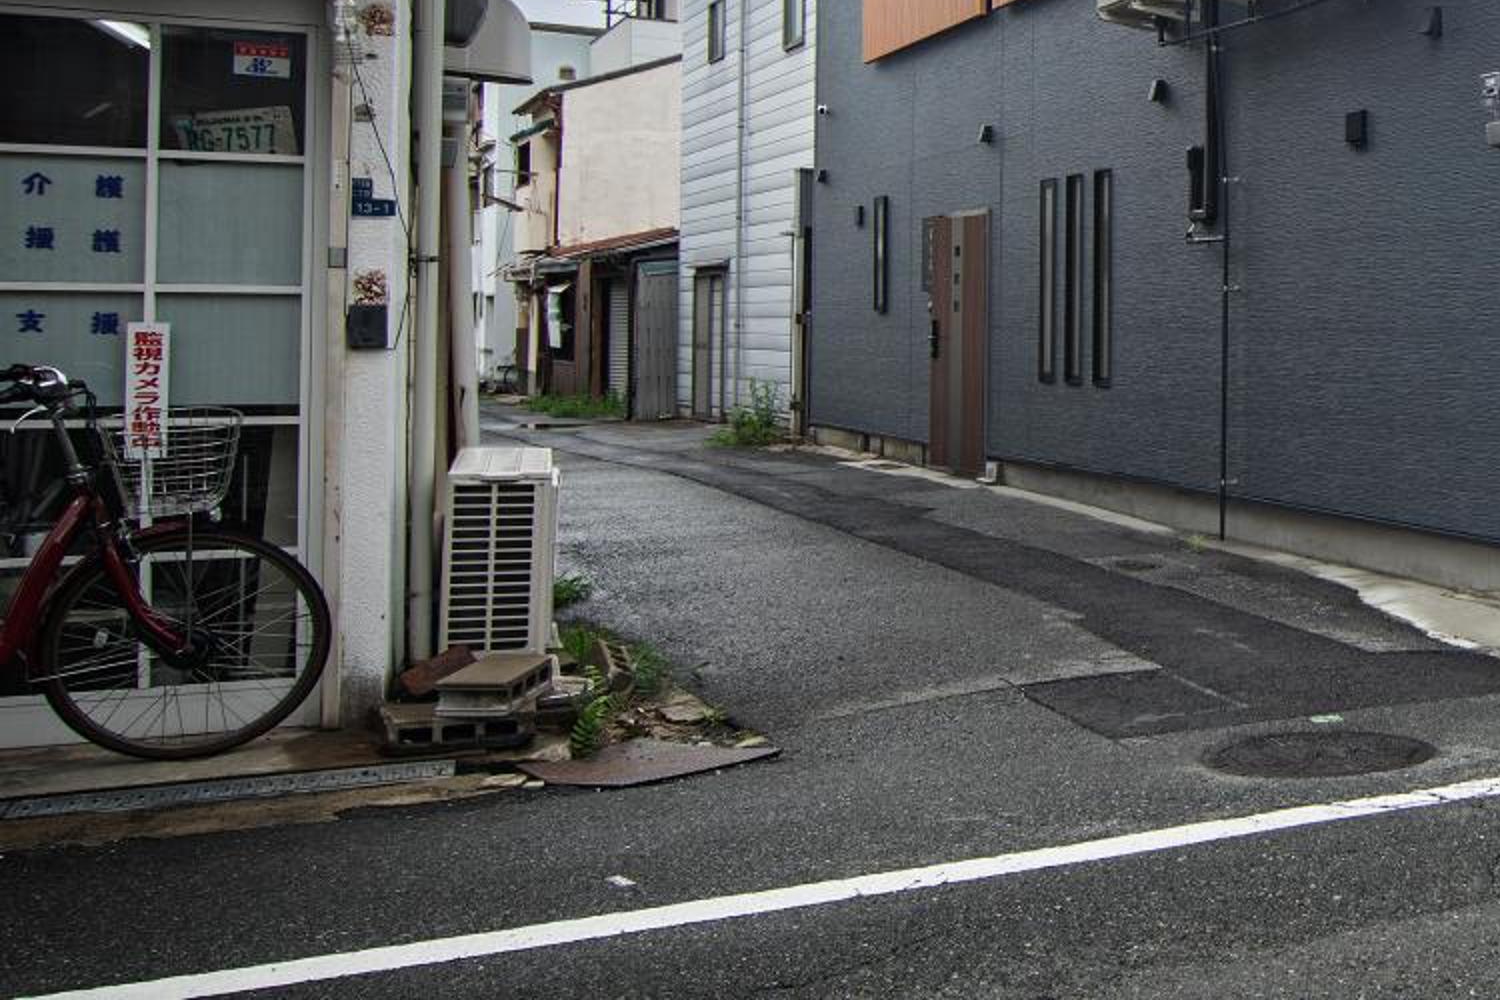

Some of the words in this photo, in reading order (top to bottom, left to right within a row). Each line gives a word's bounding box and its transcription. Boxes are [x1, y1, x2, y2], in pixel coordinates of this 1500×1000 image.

[131, 331, 163, 449] 監視カメラ作動中
